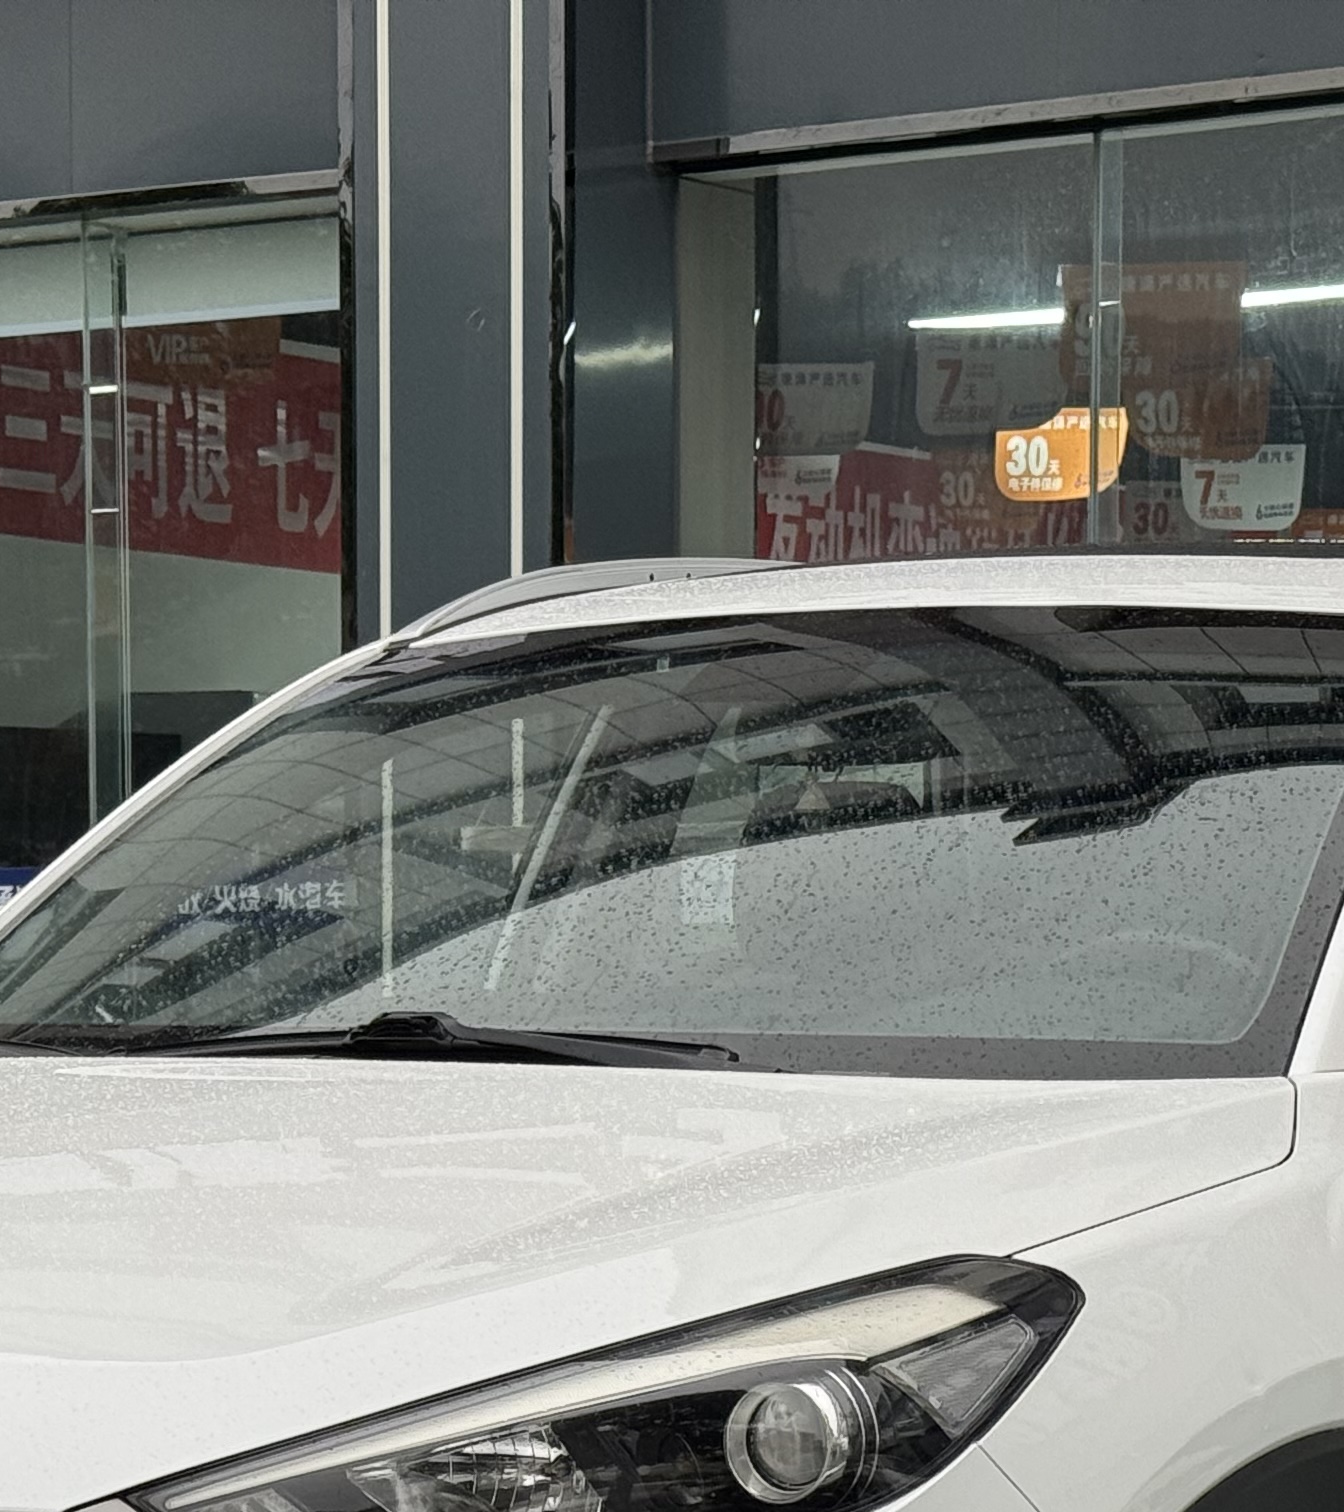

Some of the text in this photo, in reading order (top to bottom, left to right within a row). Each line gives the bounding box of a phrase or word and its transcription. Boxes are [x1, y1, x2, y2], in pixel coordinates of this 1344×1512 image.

[1135, 388, 1180, 435] 30
[1006, 434, 1050, 477] 30
[1047, 459, 1061, 477] 天
[938, 470, 976, 508] 30
[1194, 469, 1215, 505] 7
[1131, 500, 1171, 537] 30
